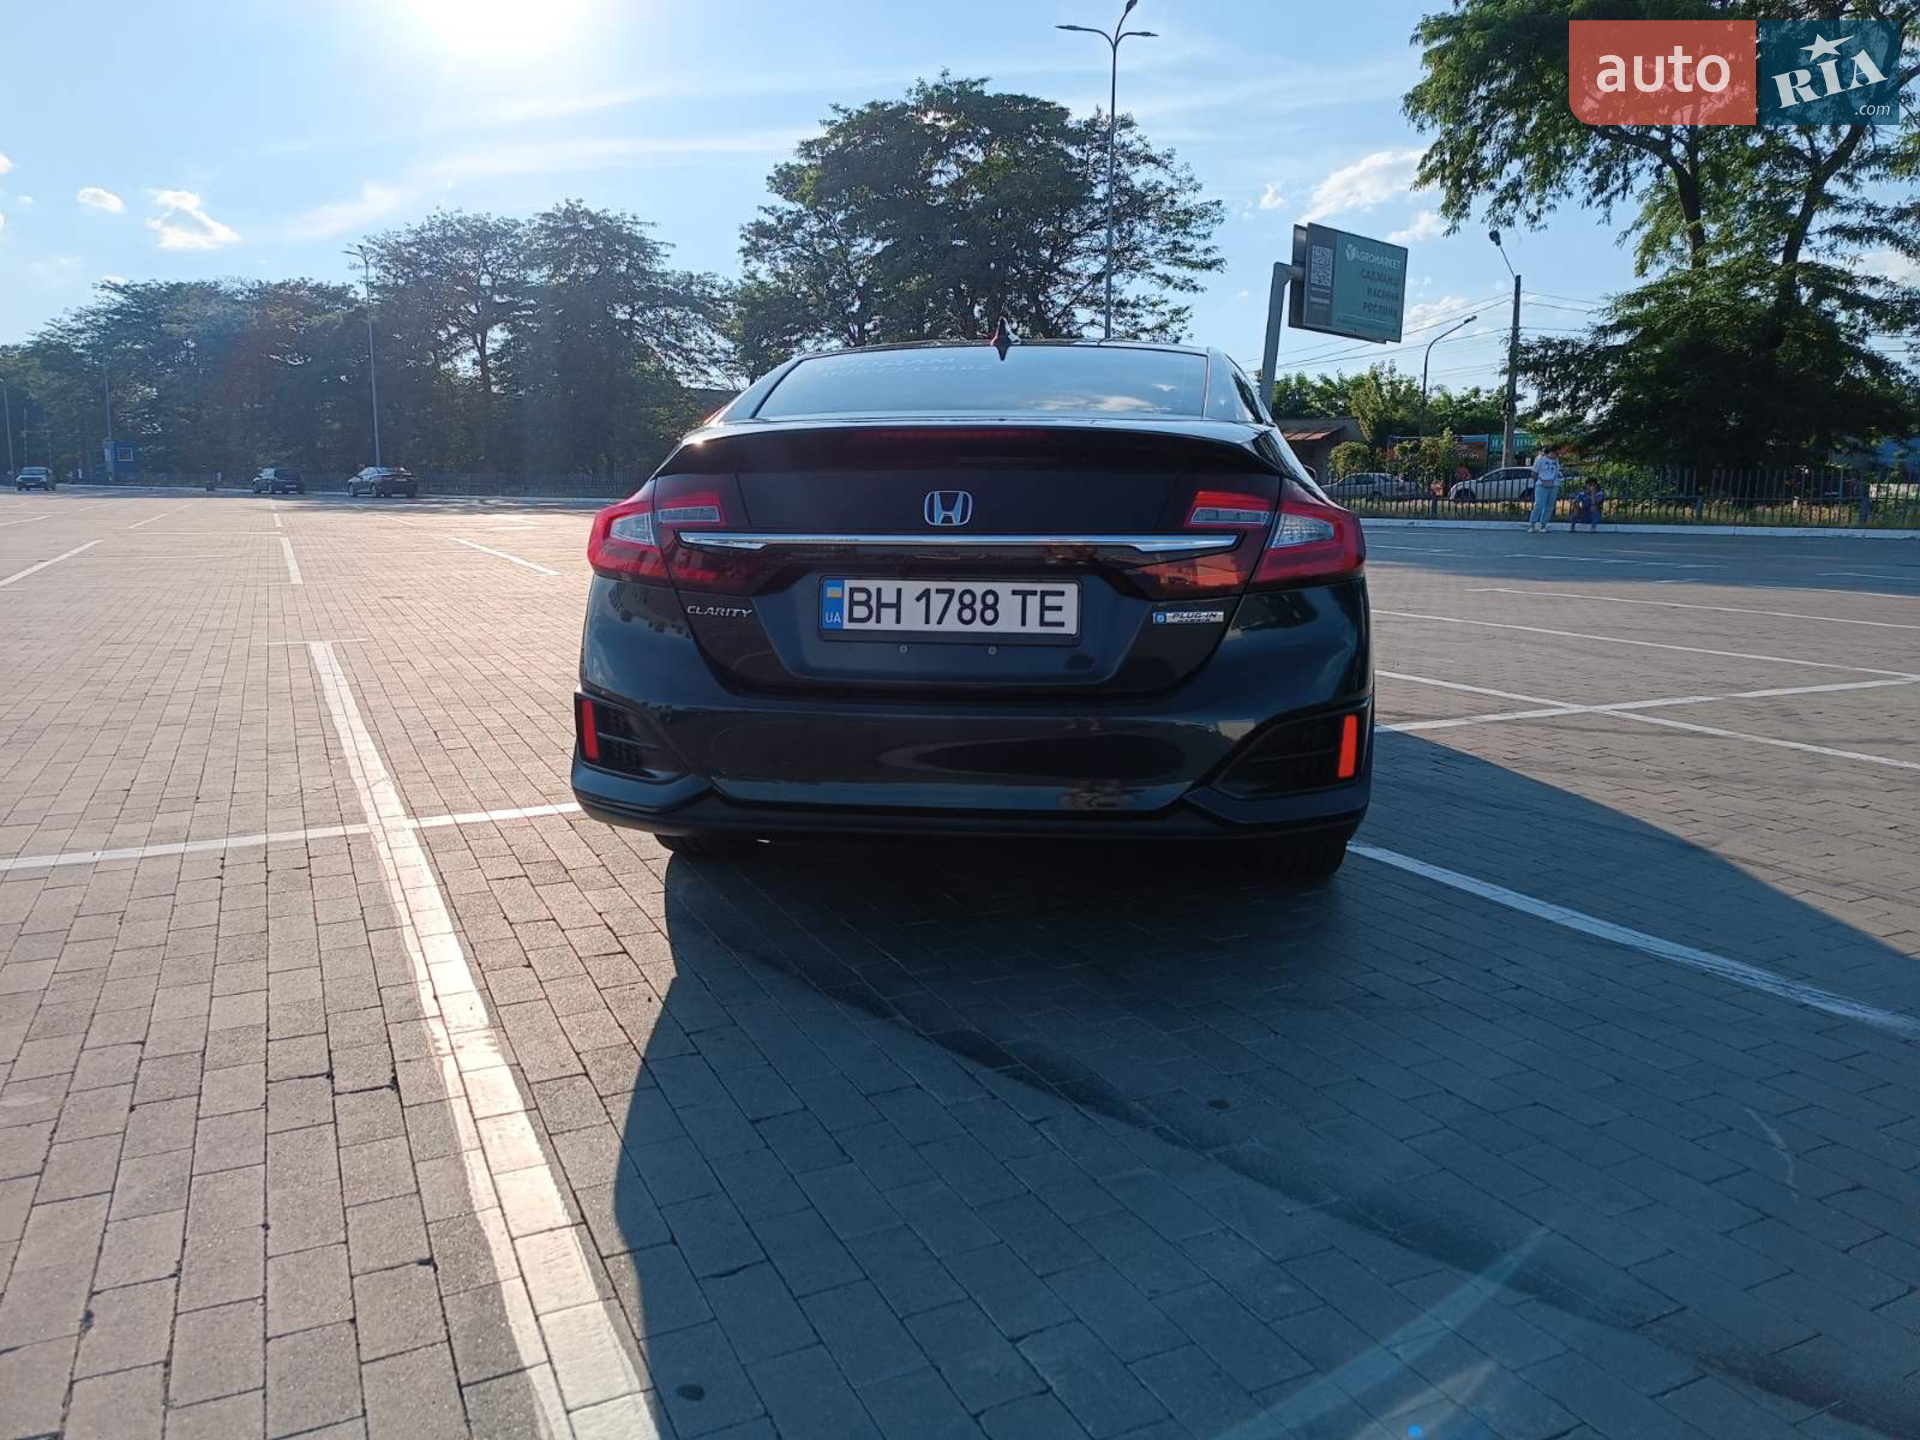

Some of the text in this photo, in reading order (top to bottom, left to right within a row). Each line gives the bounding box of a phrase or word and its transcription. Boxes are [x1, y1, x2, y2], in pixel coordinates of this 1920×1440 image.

[1356, 249, 1400, 270] AGROMARKET
[686, 605, 753, 618] CLARITY
[847, 587, 1065, 628] BH 1788 TE
[825, 611, 841, 624] UA
[1172, 611, 1216, 619] PLUG-IN
